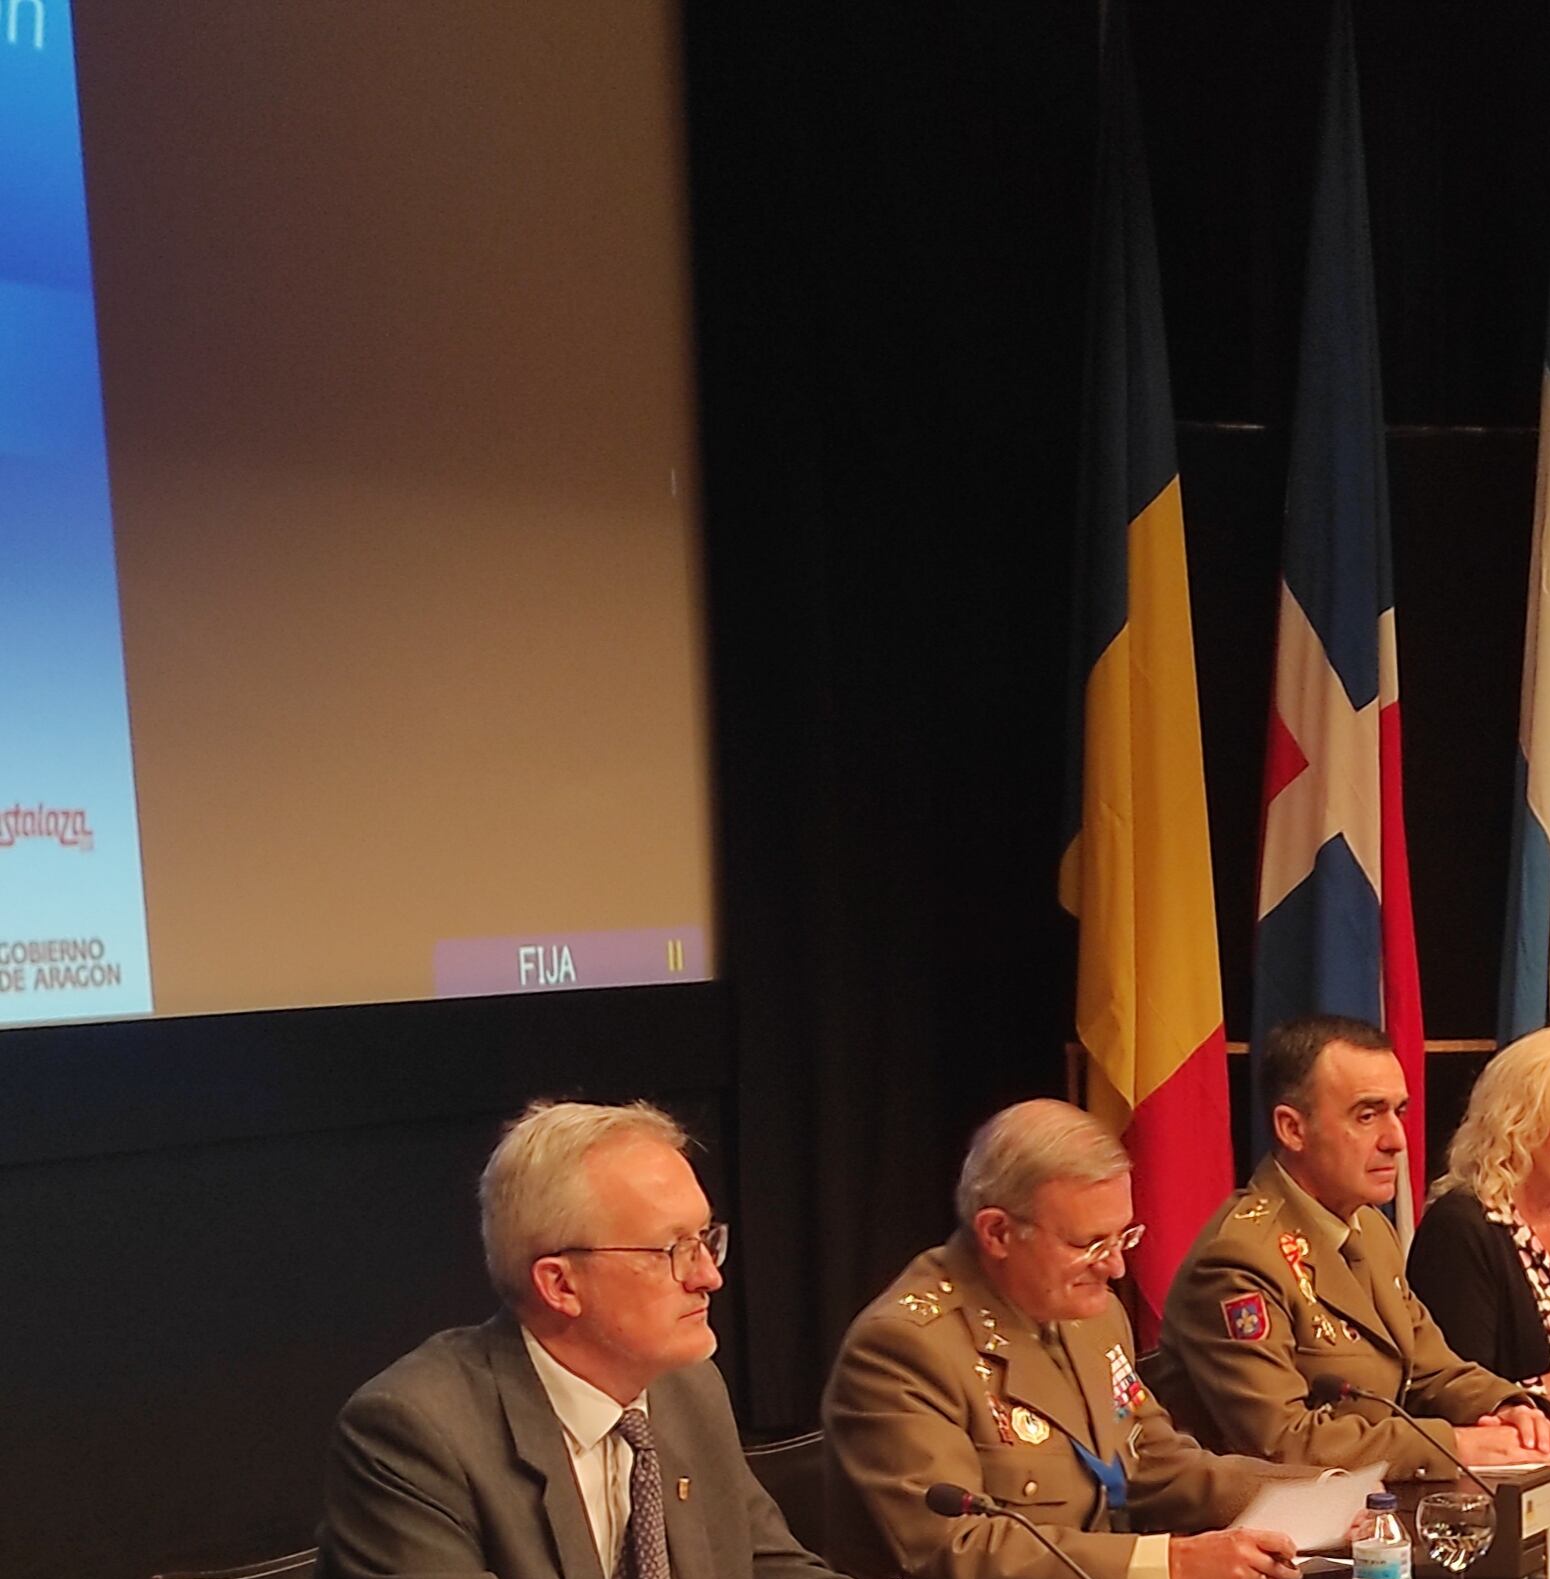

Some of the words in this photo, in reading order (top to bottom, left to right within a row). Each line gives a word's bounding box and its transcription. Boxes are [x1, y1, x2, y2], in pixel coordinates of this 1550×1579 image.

[0, 939, 105, 965] GOBIERNO
[518, 944, 577, 986] FIJA
[0, 970, 25, 992] DE
